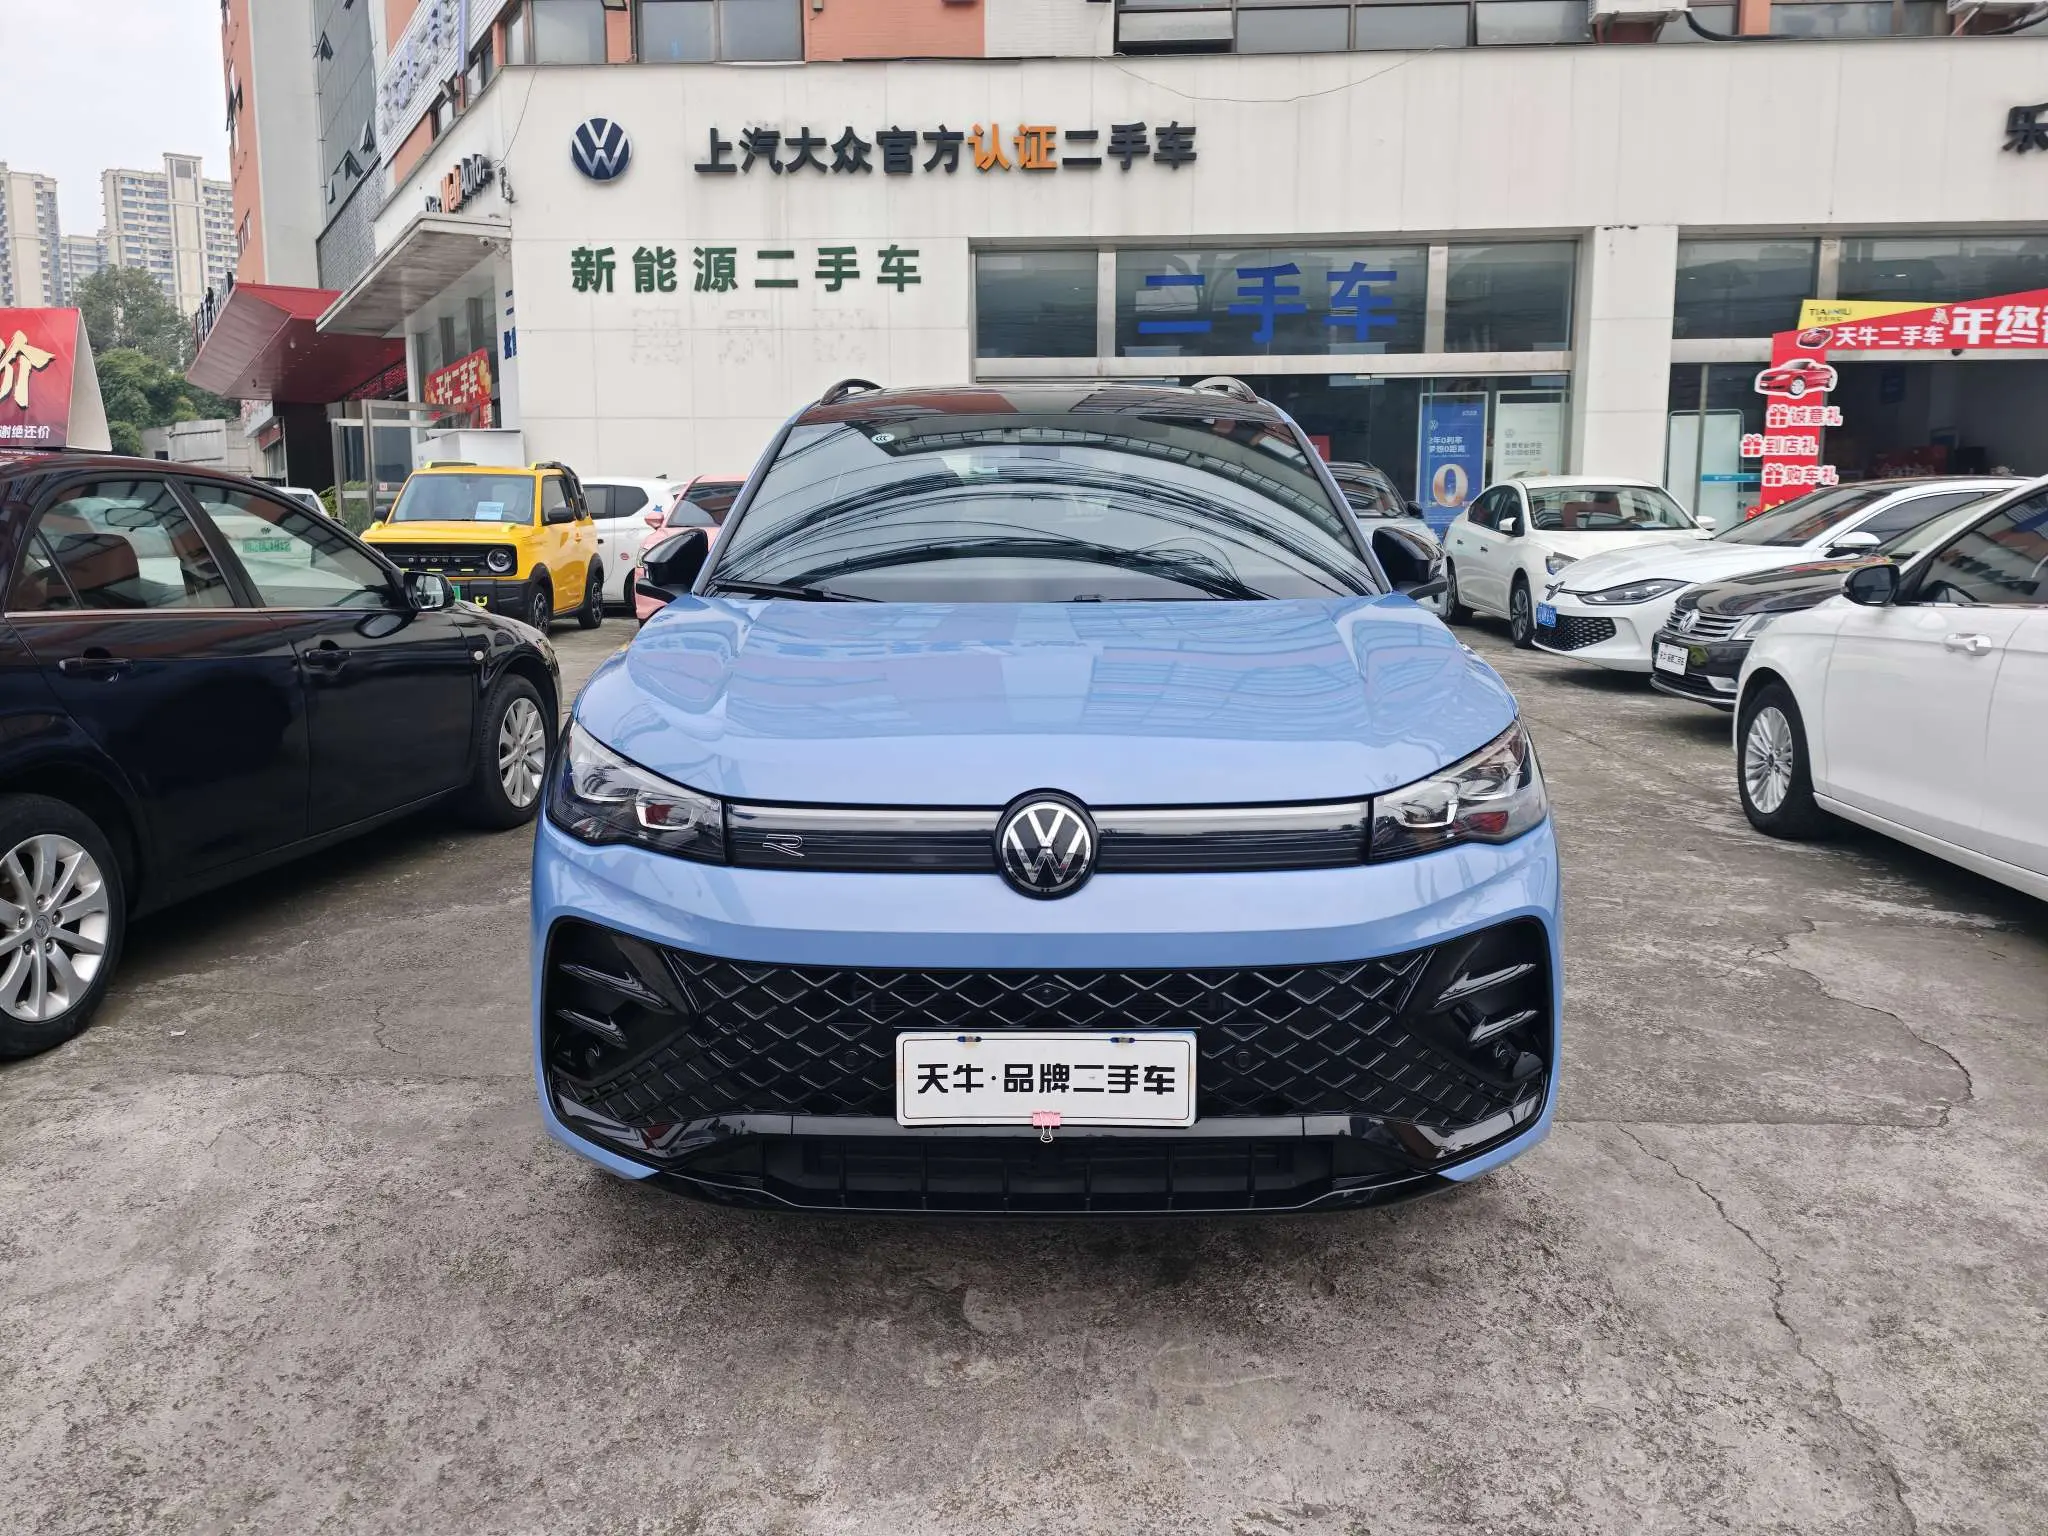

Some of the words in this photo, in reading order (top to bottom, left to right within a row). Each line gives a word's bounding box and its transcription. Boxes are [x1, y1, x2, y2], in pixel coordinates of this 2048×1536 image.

[693, 121, 1198, 177] 上汽大众官方认证二手车
[570, 243, 923, 294] 新能源二手车
[1137, 261, 1399, 345] 二手车
[1835, 325, 1946, 347] 天牛二手车
[1949, 304, 2048, 345] 年终
[435, 355, 480, 405] 天牛二手车
[1790, 406, 1843, 427] 诚意礼
[1764, 435, 1819, 456] 到店礼
[1785, 465, 1839, 486] 购车礼
